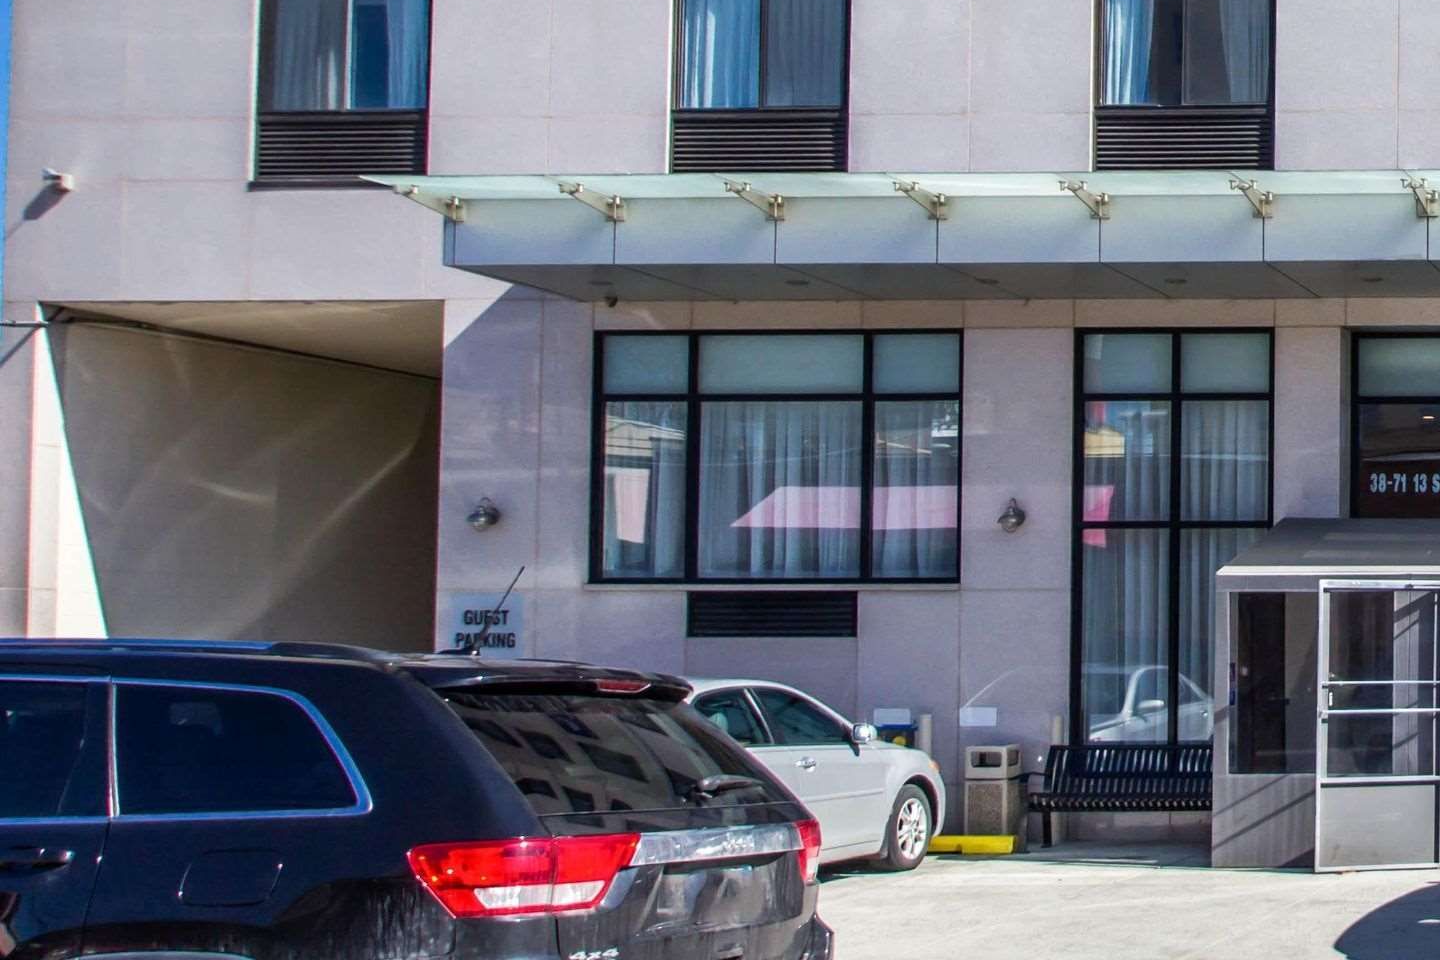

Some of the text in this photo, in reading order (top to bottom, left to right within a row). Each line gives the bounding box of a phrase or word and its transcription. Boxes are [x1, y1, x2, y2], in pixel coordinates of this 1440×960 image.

[1370, 473, 1407, 493] 38-71
[1413, 473, 1428, 493] 13
[463, 609, 509, 625] GUEST
[455, 632, 516, 648] PARKING
